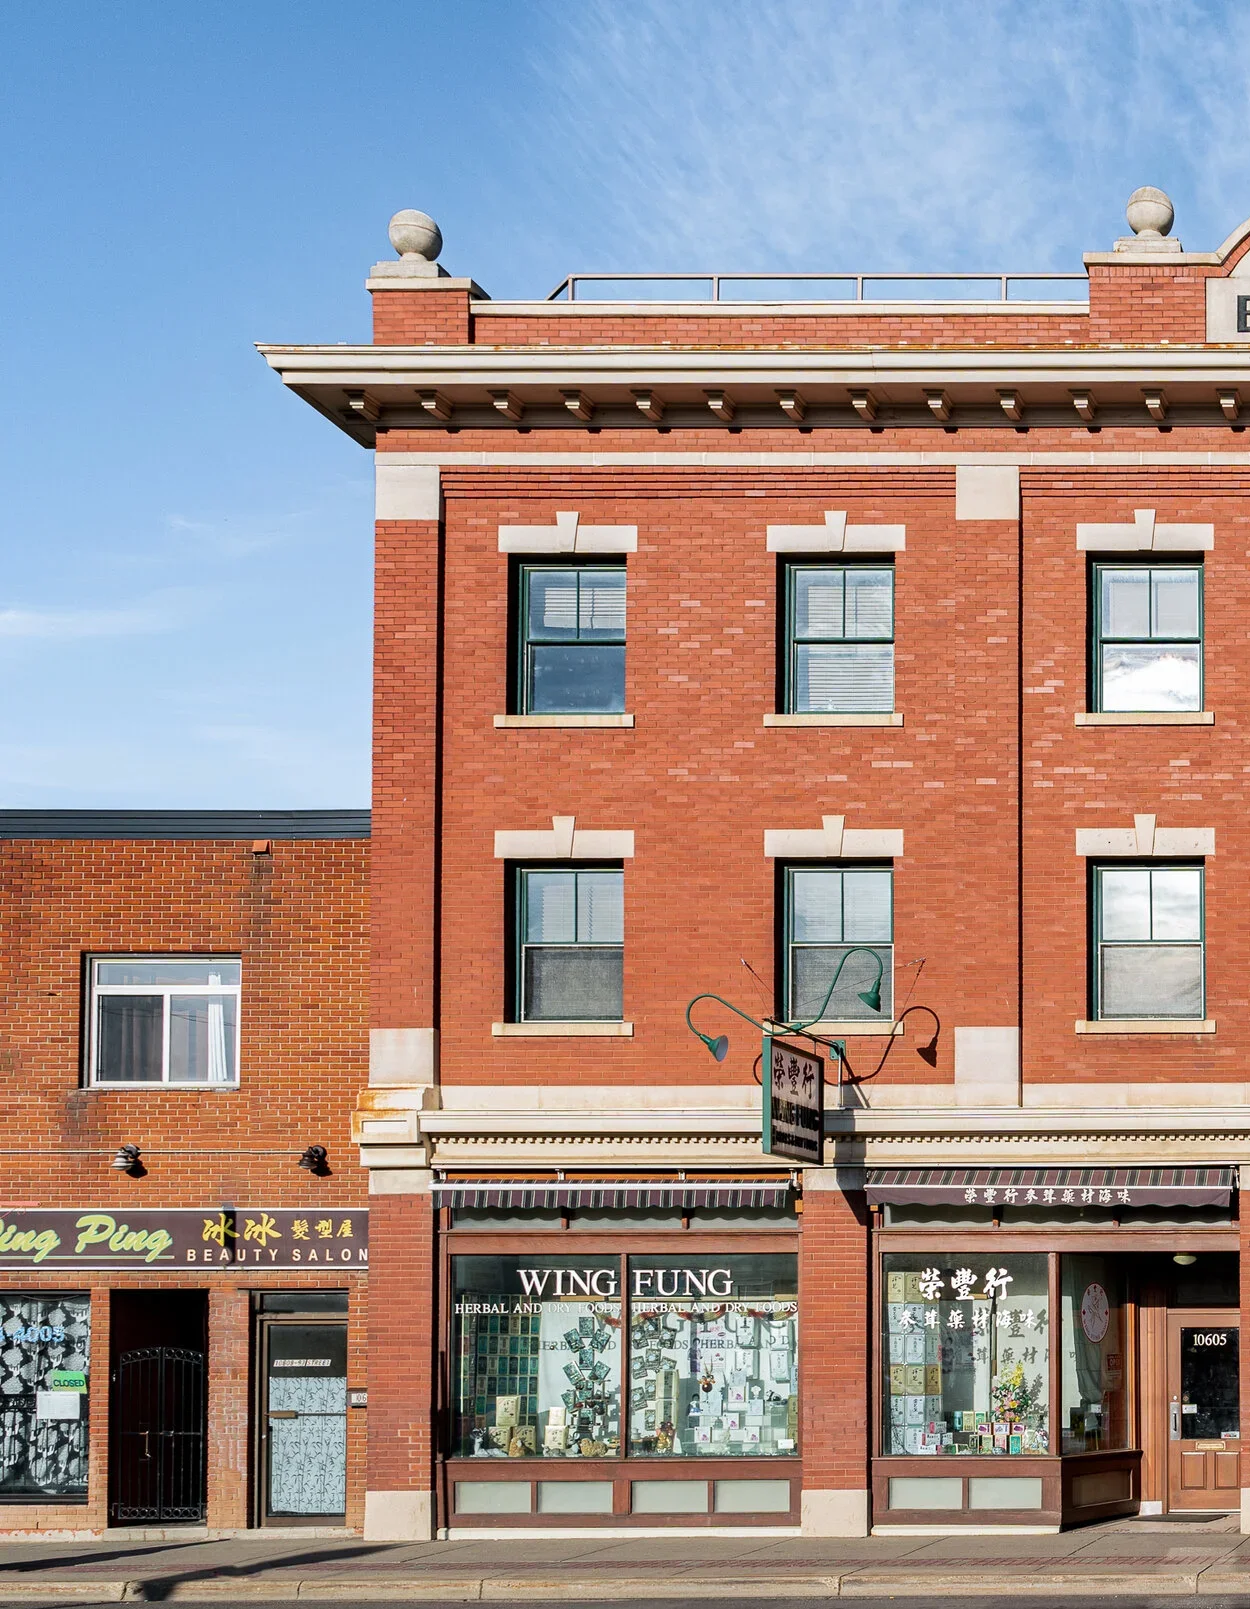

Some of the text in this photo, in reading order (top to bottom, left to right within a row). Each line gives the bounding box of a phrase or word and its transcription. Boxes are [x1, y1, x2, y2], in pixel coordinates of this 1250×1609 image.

[0, 1214, 173, 1263] ing Ping
[186, 1248, 368, 1262] BEAUTY SALON
[516, 1269, 734, 1297] WING FUNG
[918, 1267, 1014, 1301] 榮豐行
[455, 1302, 621, 1314] HERBAL AND DRY FOODS
[632, 1301, 798, 1313] HERBAL AND DRY FOODS
[1193, 1333, 1227, 1346] 10605
[53, 1379, 85, 1388] CLOSED
